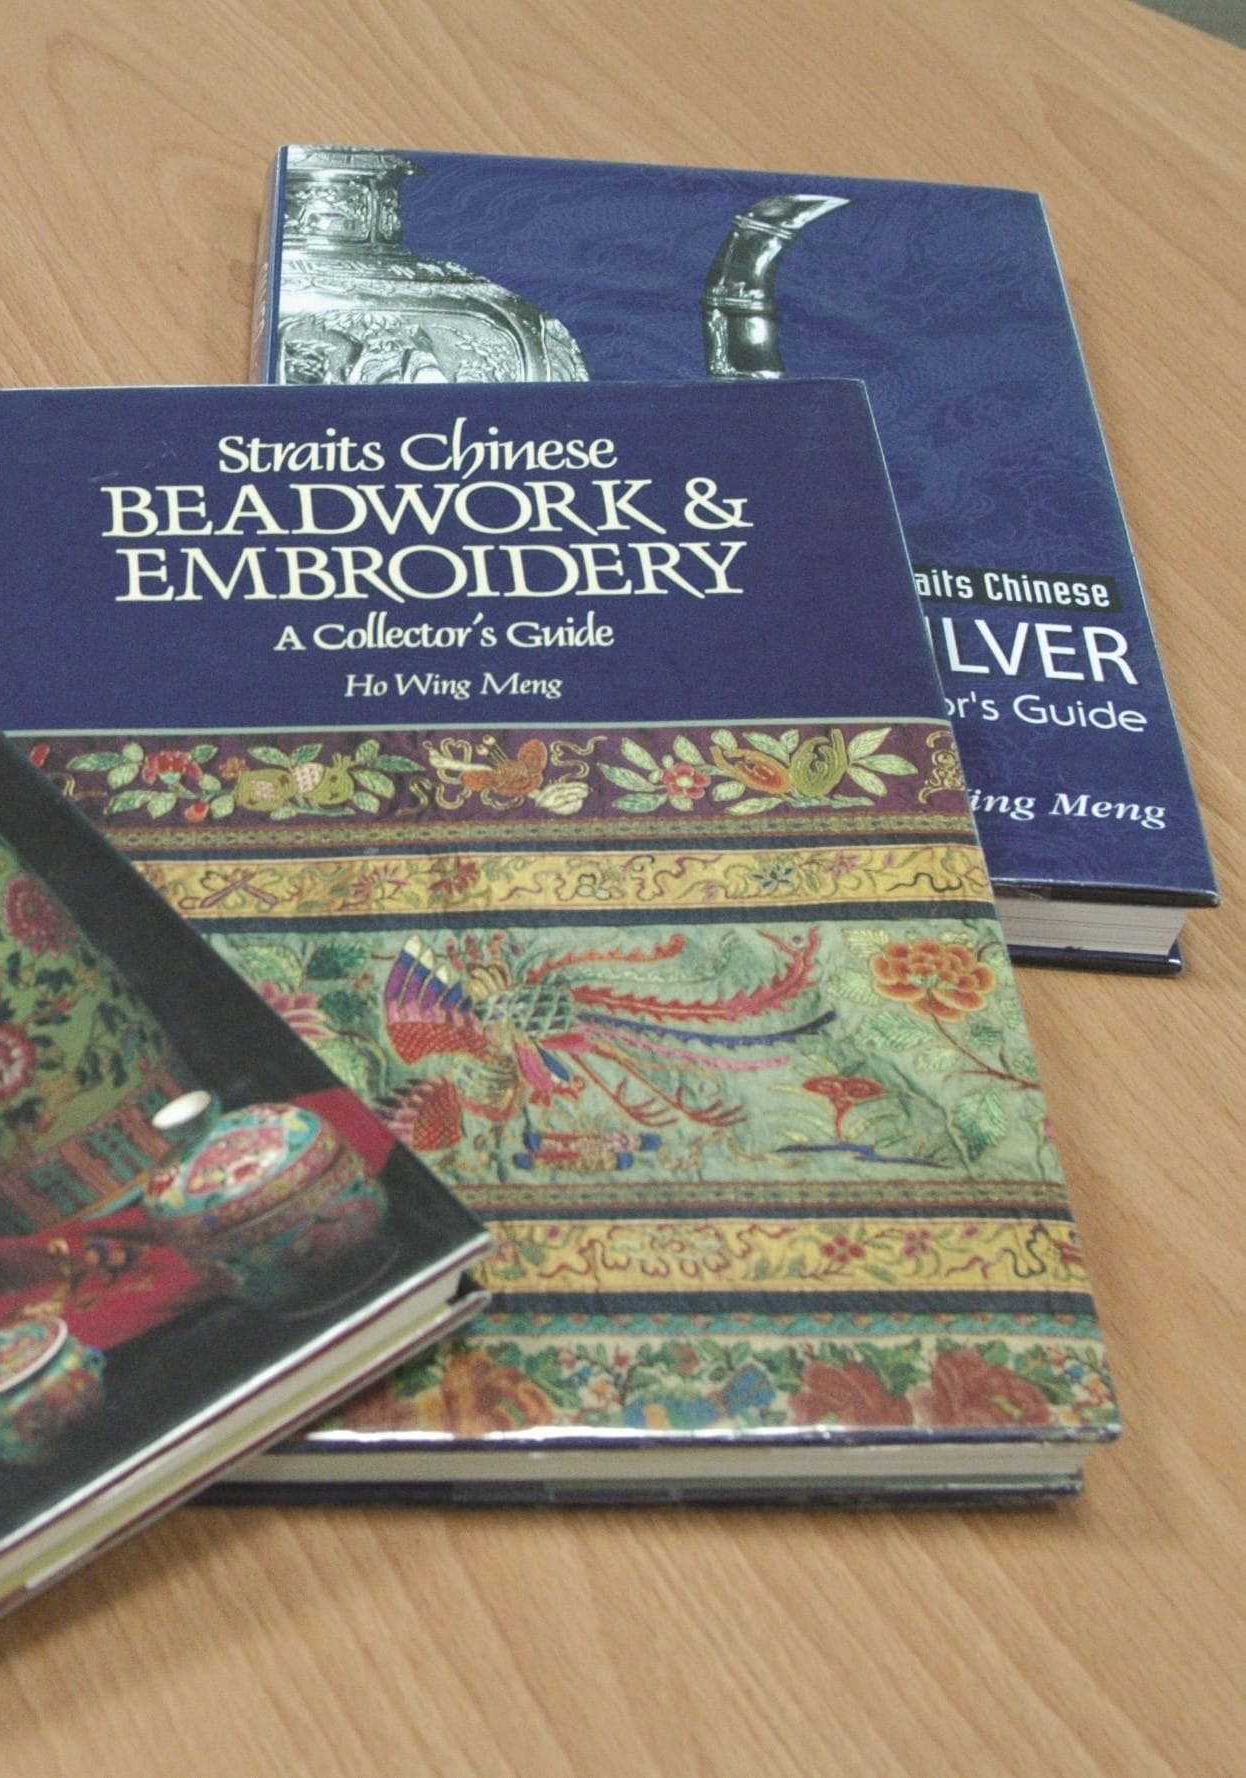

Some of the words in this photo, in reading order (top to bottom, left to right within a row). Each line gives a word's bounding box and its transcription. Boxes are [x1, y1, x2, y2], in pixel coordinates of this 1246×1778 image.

[218, 427, 386, 474] Straits
[400, 416, 618, 480] Chinese
[100, 479, 667, 538] BEADWORK
[684, 477, 754, 530] &
[115, 541, 747, 604] EMBROIDERY
[914, 569, 974, 599] aits
[983, 571, 1111, 607] Chinese
[273, 625, 307, 651] A
[313, 611, 498, 651] Collector's
[506, 610, 615, 648] Guide
[345, 673, 388, 697] Ho
[395, 672, 471, 700] Wing
[480, 672, 563, 700] Meng
[1012, 694, 1148, 733] Guide
[967, 788, 1036, 821] ing
[1048, 792, 1166, 830] Meng
